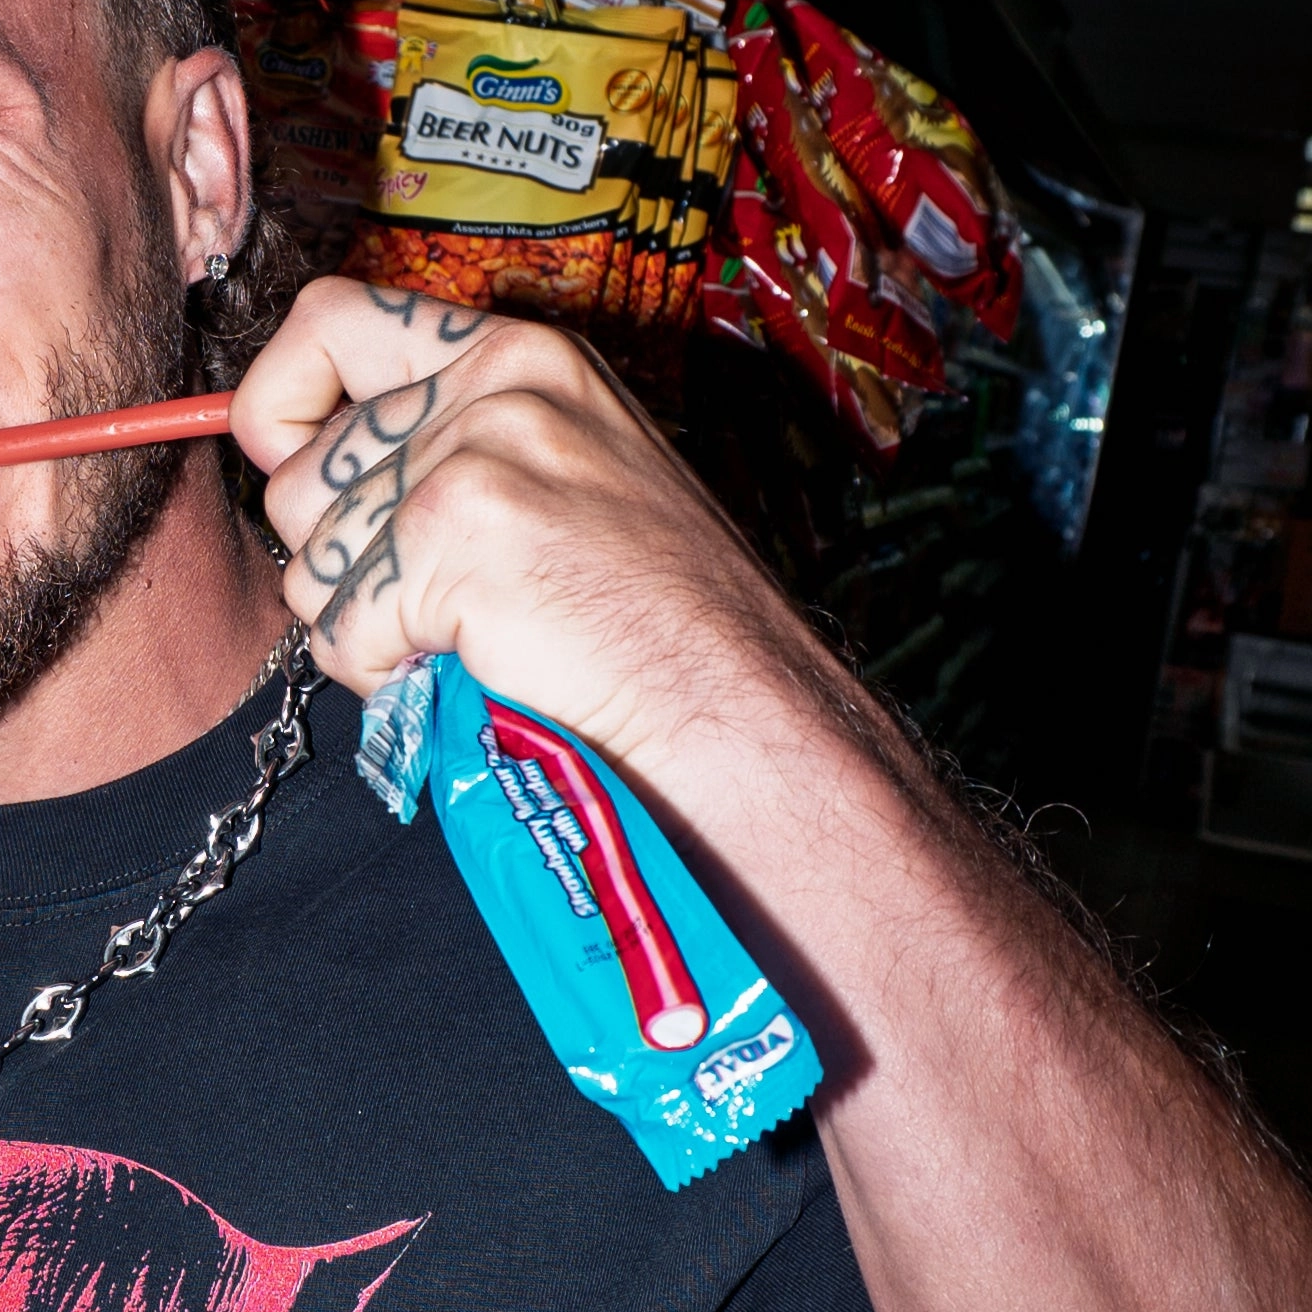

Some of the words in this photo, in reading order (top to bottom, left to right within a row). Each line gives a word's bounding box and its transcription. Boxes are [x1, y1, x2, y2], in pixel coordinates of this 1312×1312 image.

[473, 72, 563, 105] Ginni's
[271, 124, 351, 153] CASHEW
[418, 111, 488, 146] BEER
[497, 123, 583, 170] NUTS
[551, 113, 596, 137] 90g
[377, 166, 428, 201] Spicy
[451, 221, 503, 238] Assorted
[505, 222, 534, 238] Nuts
[535, 223, 556, 238] and
[557, 217, 610, 237] Crackers
[550, 803, 590, 853] with
[528, 816, 600, 919] Strawberry
[707, 1028, 793, 1088] VIDAL
